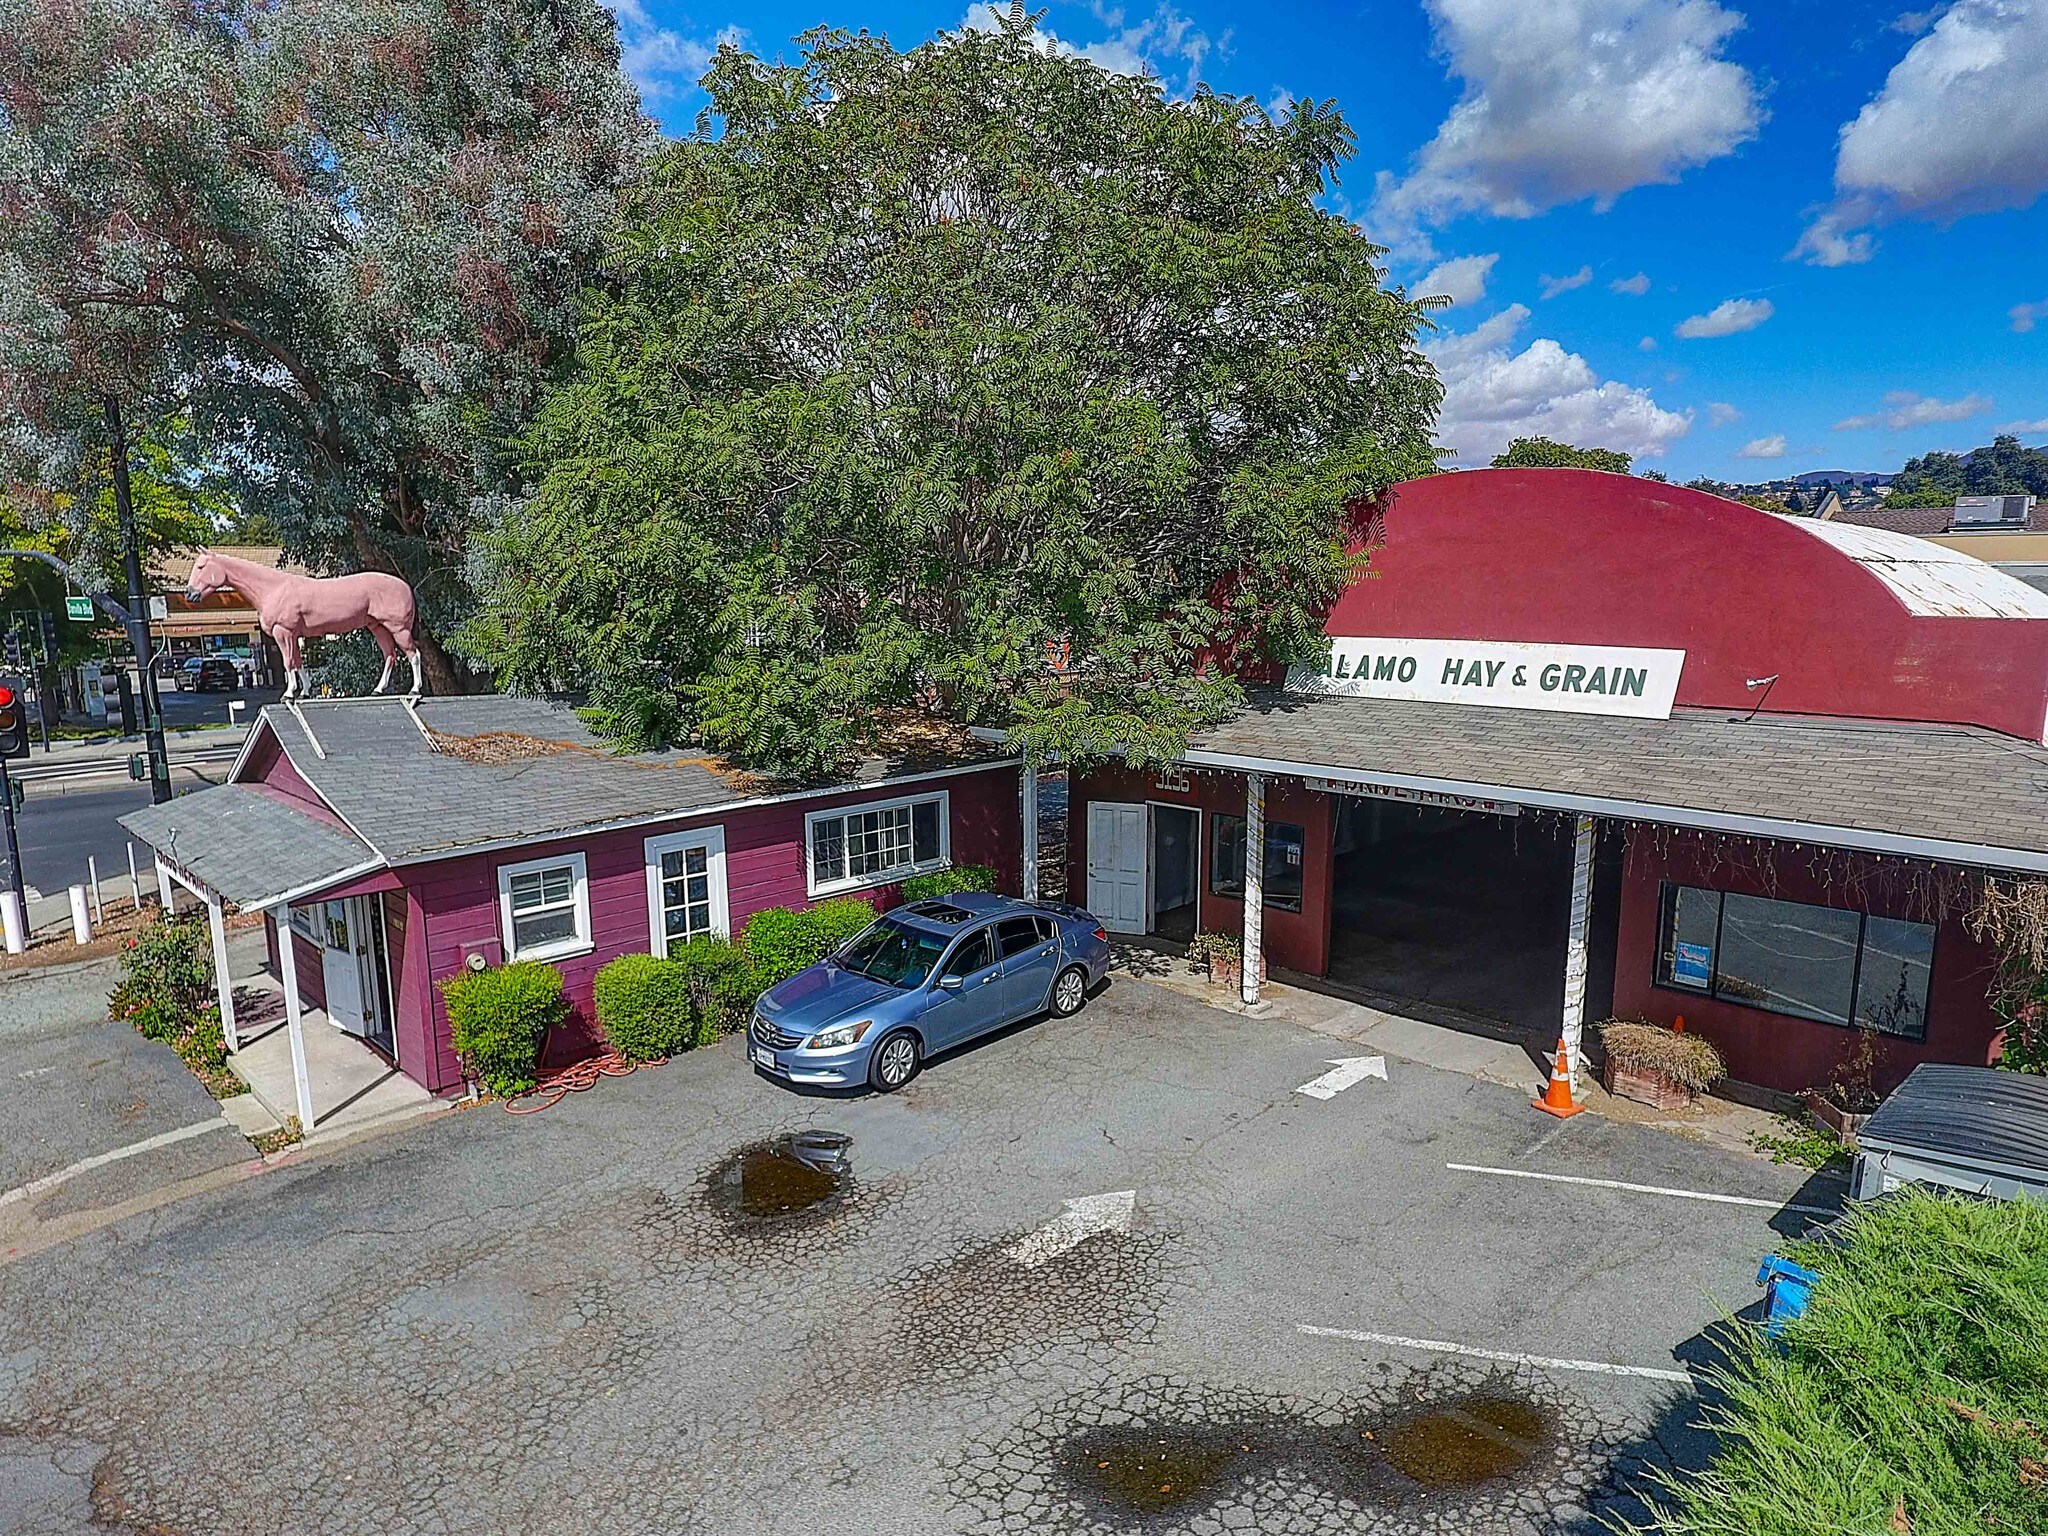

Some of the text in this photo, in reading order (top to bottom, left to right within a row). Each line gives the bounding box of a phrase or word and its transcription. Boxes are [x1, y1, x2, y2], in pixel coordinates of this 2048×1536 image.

[1316, 653, 1648, 697] ALAMO HAY & GRAIN
